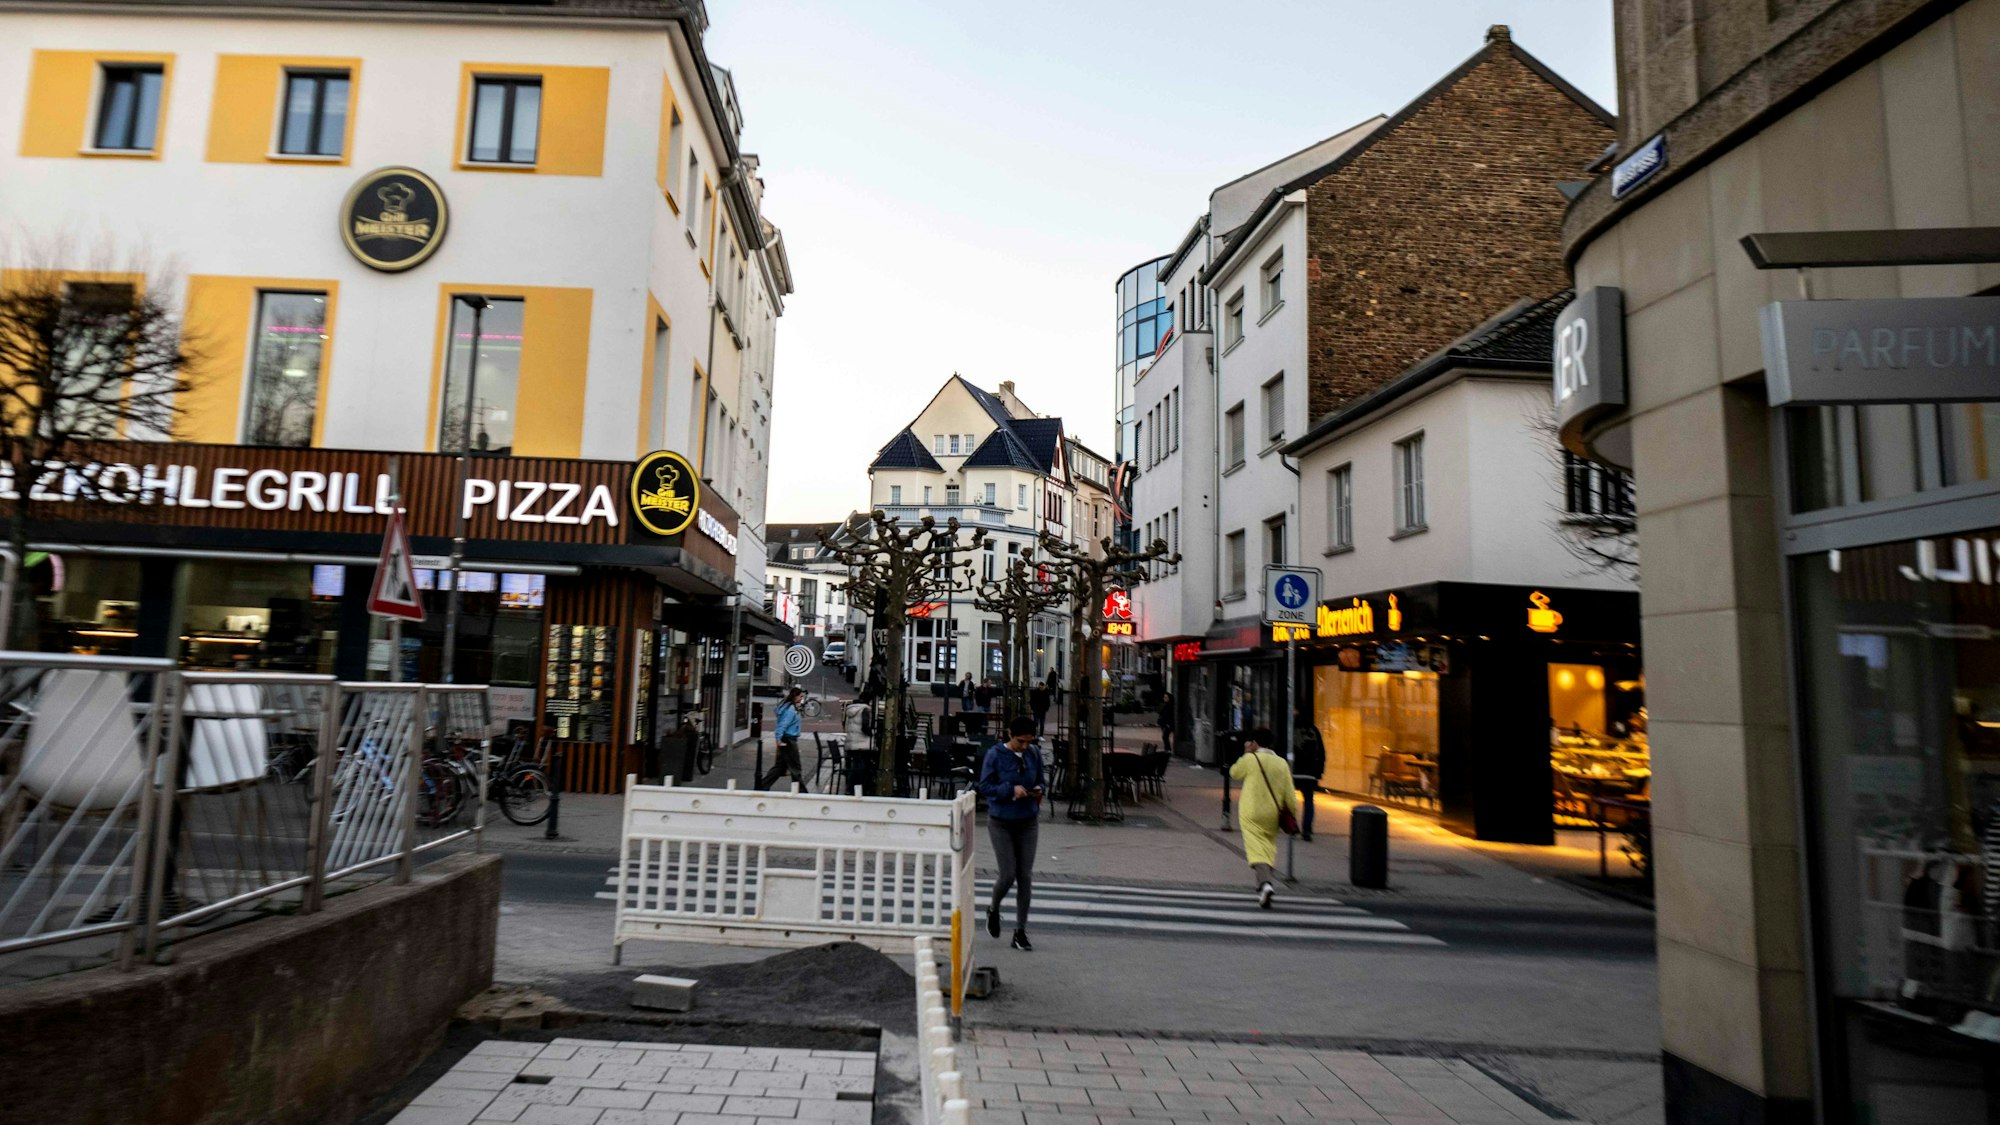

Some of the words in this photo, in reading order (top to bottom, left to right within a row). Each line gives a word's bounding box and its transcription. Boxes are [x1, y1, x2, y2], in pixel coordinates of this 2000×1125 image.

[355, 221, 430, 238] MEISTER
[462, 478, 619, 527] PIZZA
[640, 493, 690, 512] MEISTER
[1278, 610, 1305, 621] ZONE
